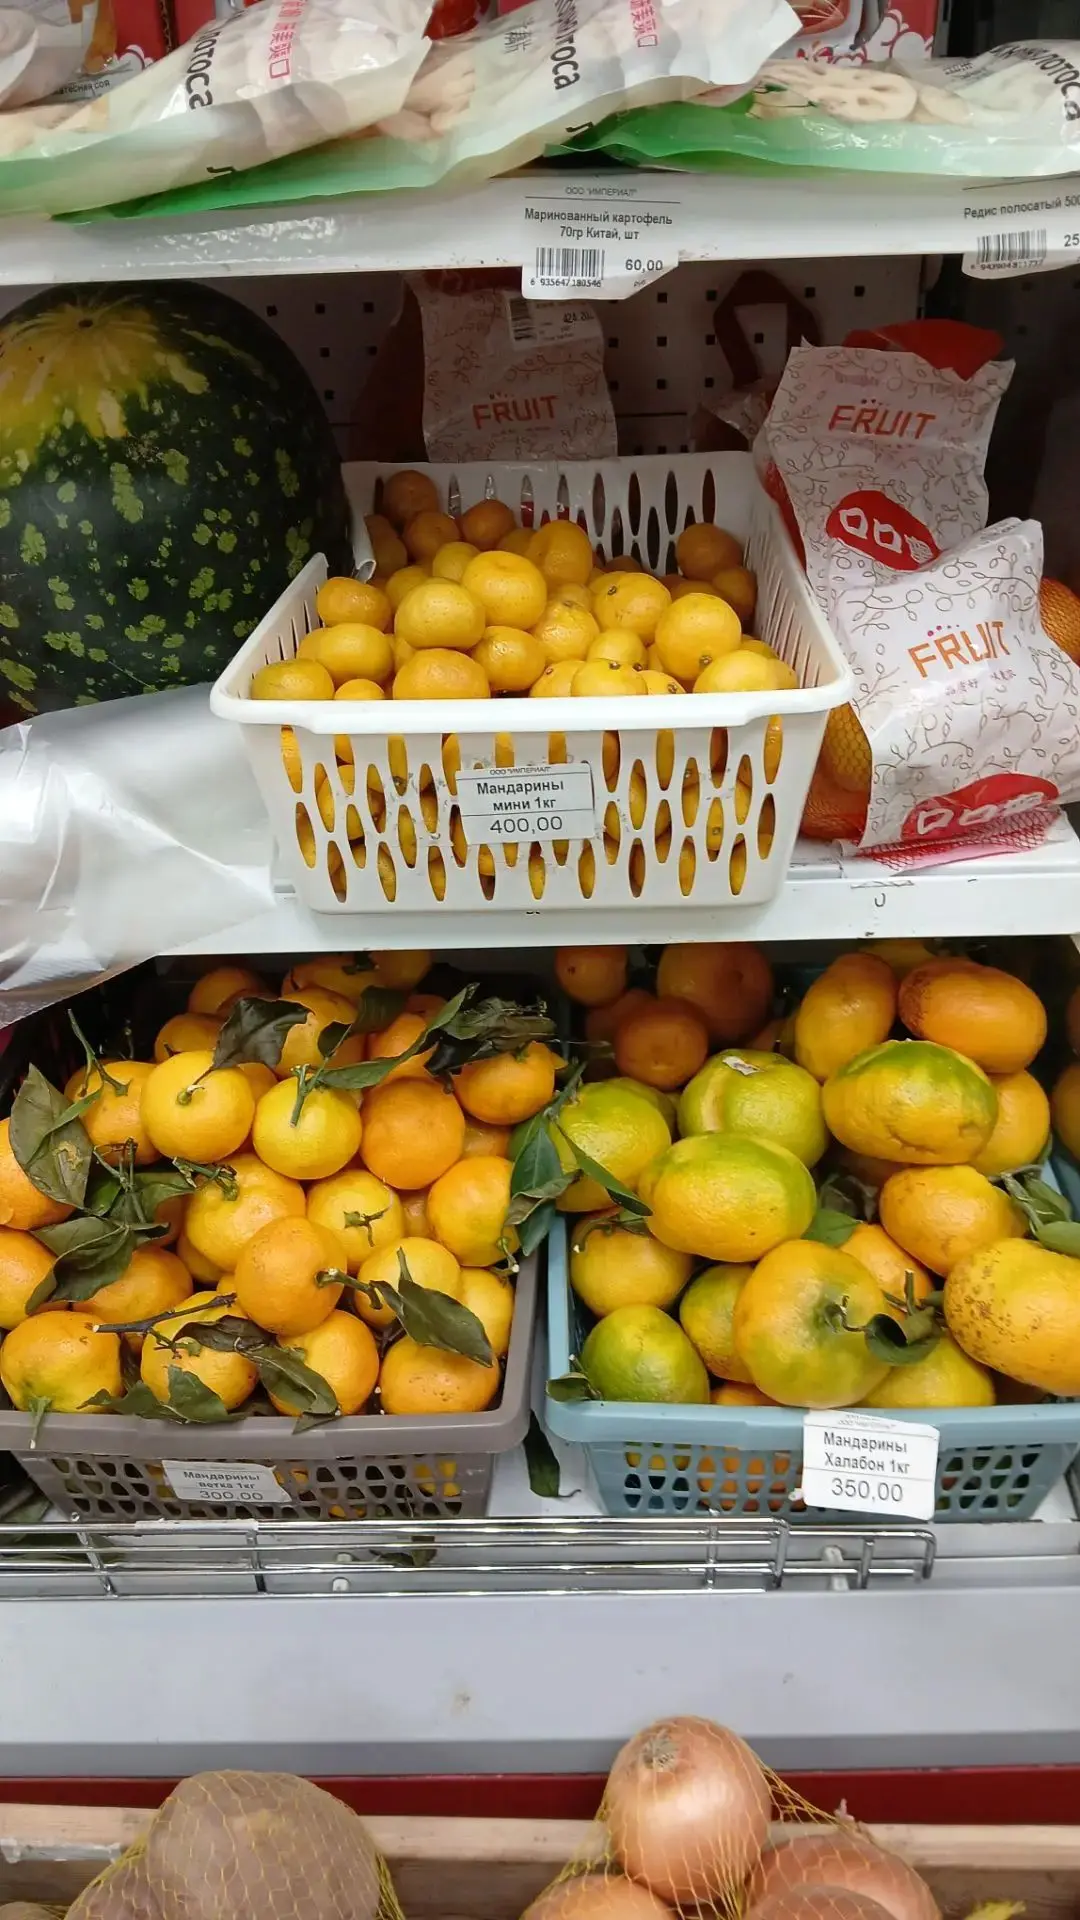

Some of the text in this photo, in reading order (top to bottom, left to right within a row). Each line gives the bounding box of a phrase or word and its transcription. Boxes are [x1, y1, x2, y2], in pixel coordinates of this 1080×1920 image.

[565, 186, 585, 195] ООО
[524, 207, 673, 227] Маринованный картофель
[963, 207, 998, 219] Редис
[1000, 197, 1062, 215] полосатый
[560, 225, 640, 241] 70гр Китай, шт
[625, 259, 664, 274] 60,00
[472, 396, 558, 430] FRUIT
[828, 404, 936, 440] FRUIT
[907, 621, 1010, 679] FRUIT
[477, 780, 564, 796] Мандарины
[493, 797, 557, 812] мини 1кг
[490, 816, 563, 834] 400,00
[823, 1431, 908, 1453] Мандарины
[824, 1452, 911, 1474] Халабон 1кг
[183, 1471, 261, 1481] Мандарины
[831, 1478, 904, 1503] 350,00
